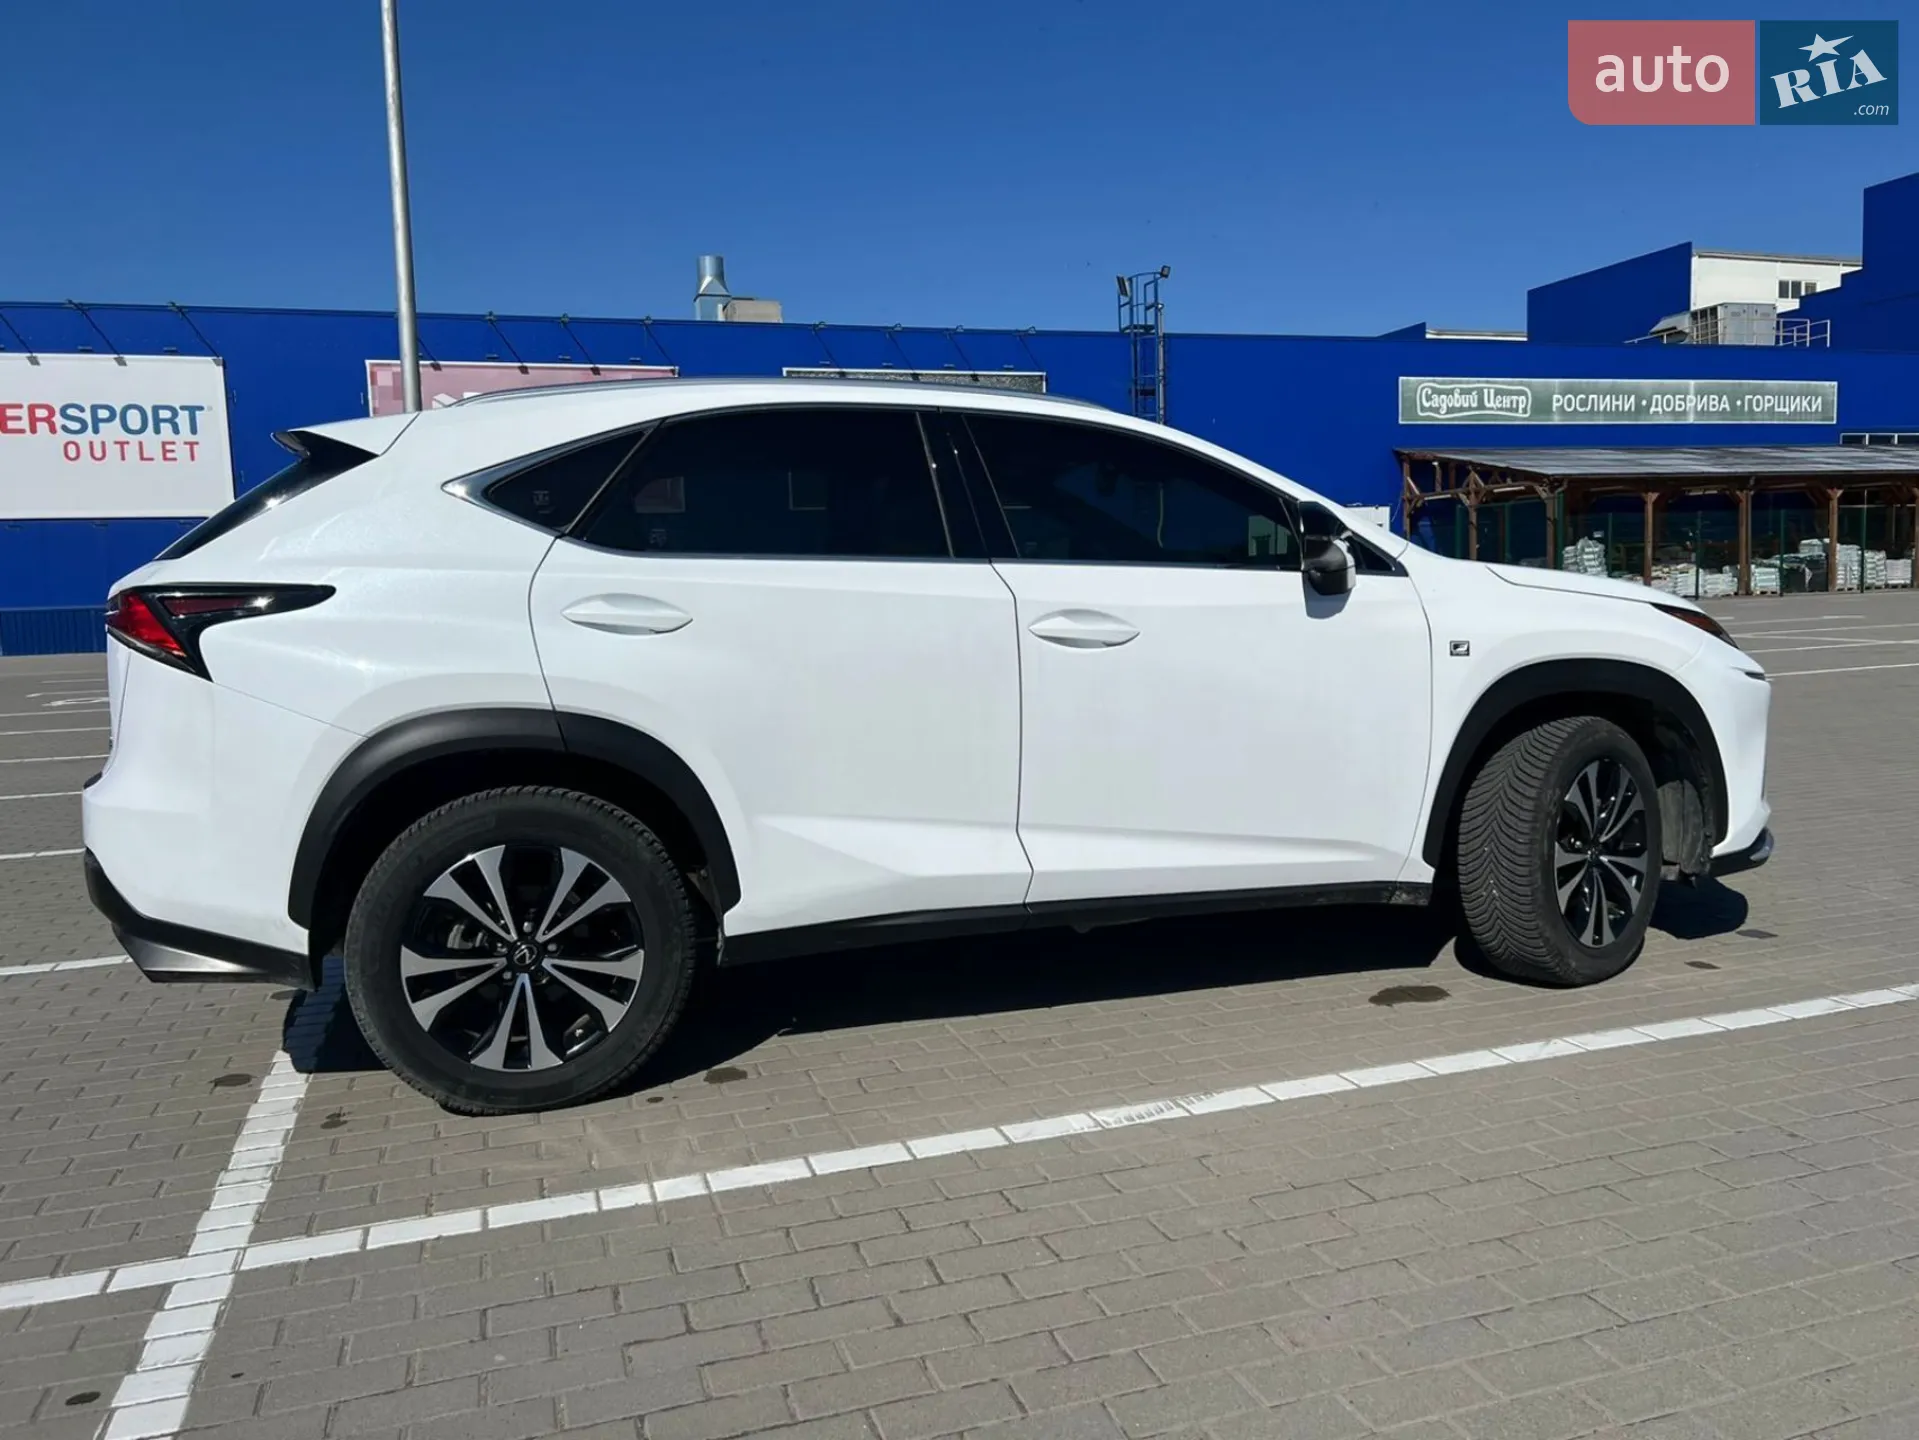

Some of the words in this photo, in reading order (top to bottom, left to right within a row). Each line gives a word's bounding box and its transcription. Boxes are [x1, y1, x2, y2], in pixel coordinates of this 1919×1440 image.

[1422, 388, 1478, 414] Садовий
[1483, 388, 1527, 414] Центр
[1552, 394, 1635, 412] РОСЛИНИ
[1649, 394, 1731, 415] ДОБРИВА
[1743, 395, 1823, 415] ГОРЩИКИ
[0, 403, 205, 436] ERSPORT
[63, 440, 199, 462] OUTLET
